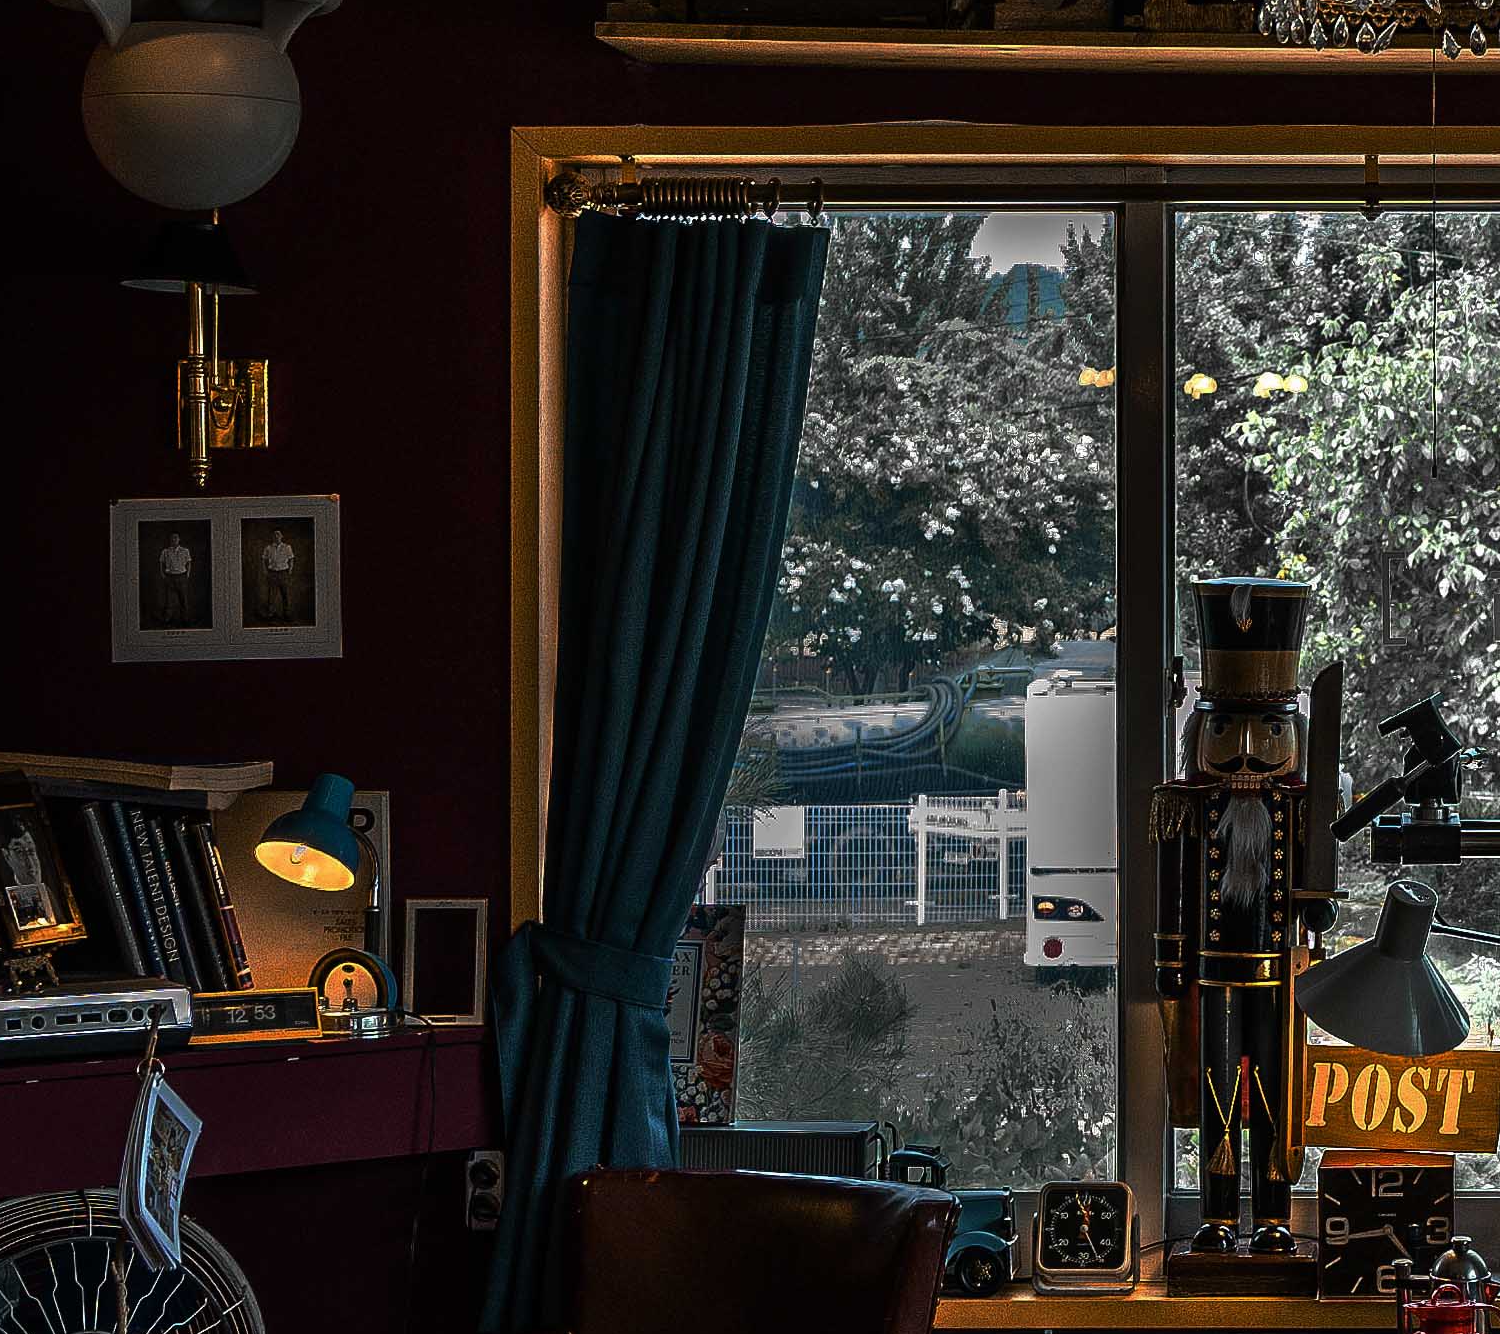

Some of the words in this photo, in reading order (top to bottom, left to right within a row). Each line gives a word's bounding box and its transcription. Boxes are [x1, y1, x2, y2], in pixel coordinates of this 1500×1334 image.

[130, 810, 150, 852] NEW
[140, 850, 166, 905] TALENT
[155, 904, 181, 963] DESIGN
[227, 1009, 249, 1024] 12
[253, 1004, 276, 1020] 53
[1304, 1061, 1476, 1135] POST
[1371, 1168, 1405, 1198] 12
[1059, 1212, 1069, 1220] 10
[1100, 1211, 1112, 1220] 50
[1057, 1238, 1069, 1246] 20
[1099, 1238, 1112, 1246] 40
[1324, 1215, 1351, 1246] 9
[1425, 1215, 1451, 1246] 3
[1078, 1252, 1090, 1260] 30
[1375, 1264, 1398, 1295] 6
